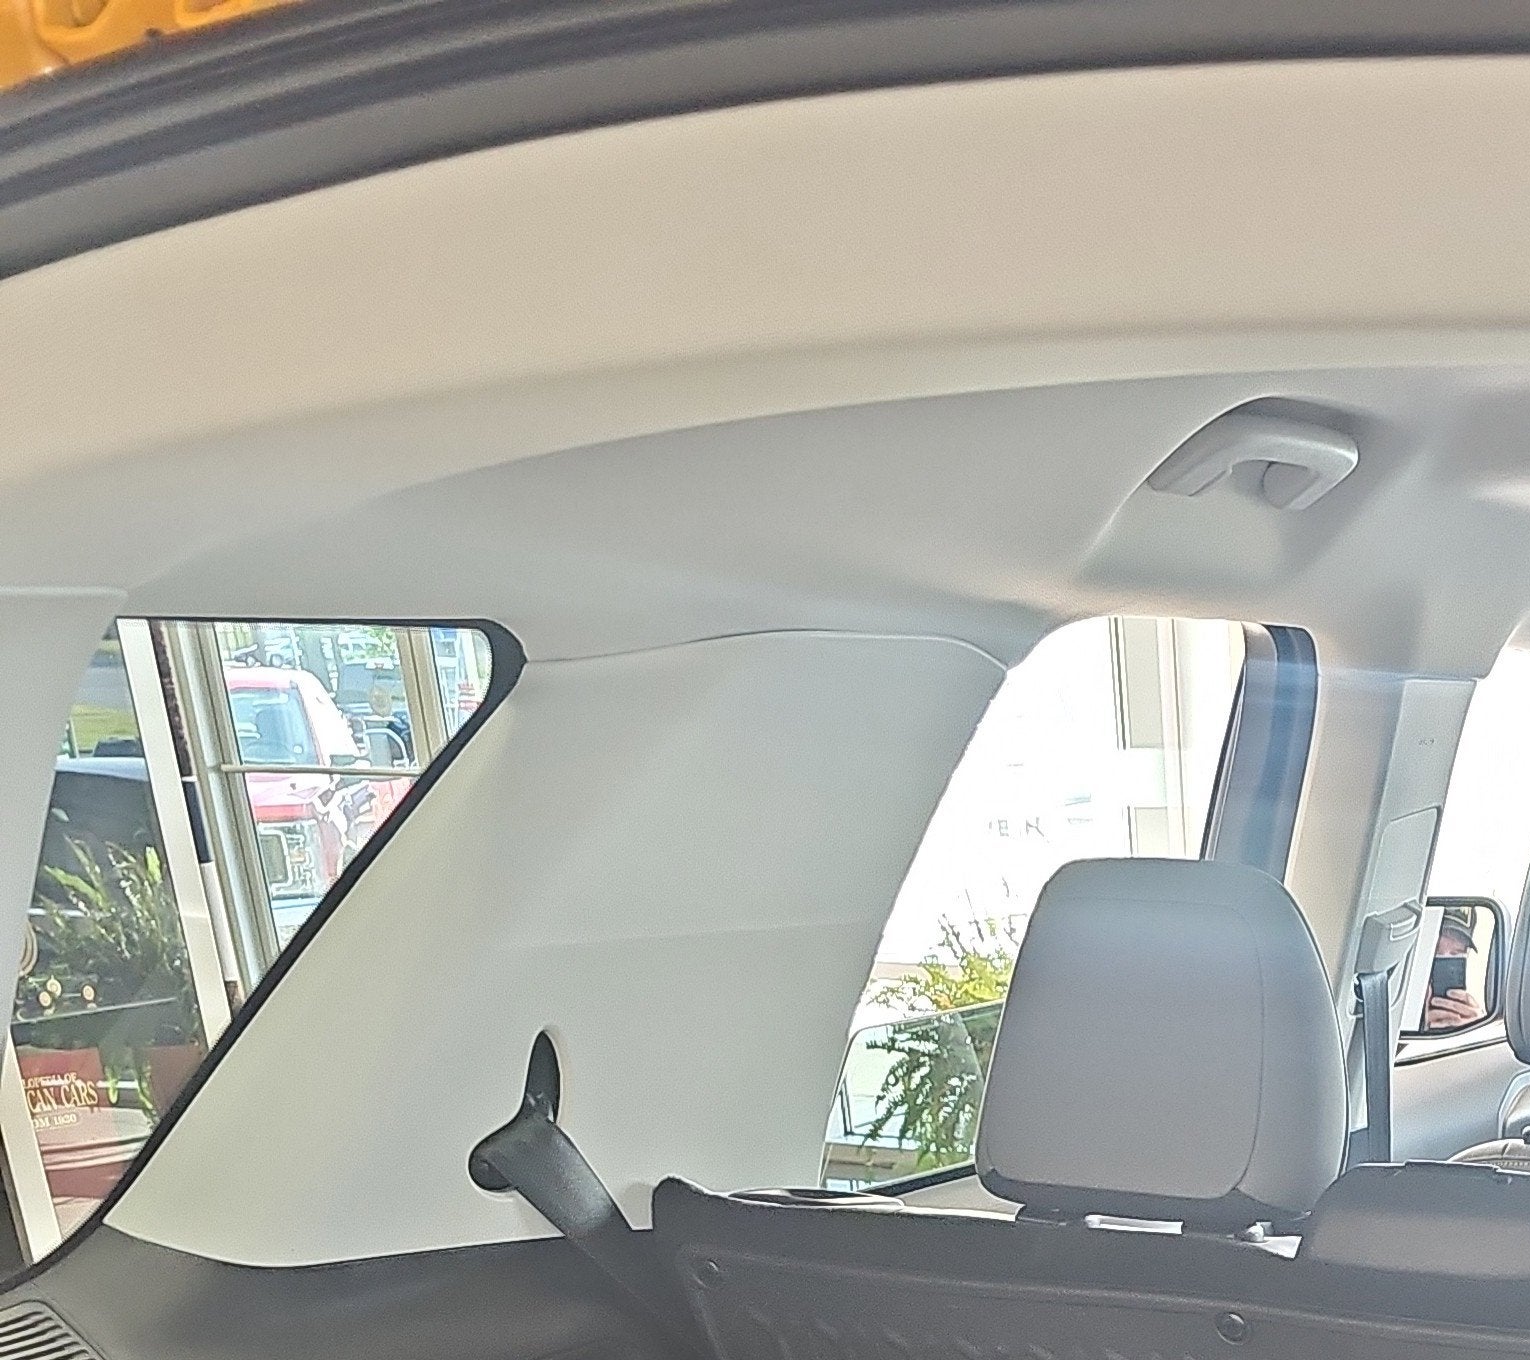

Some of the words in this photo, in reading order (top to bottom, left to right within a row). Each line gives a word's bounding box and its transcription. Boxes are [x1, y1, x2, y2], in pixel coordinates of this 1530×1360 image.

[64, 1072, 77, 1083] OF
[27, 1087, 57, 1113] CAN
[61, 1080, 98, 1107] CARS
